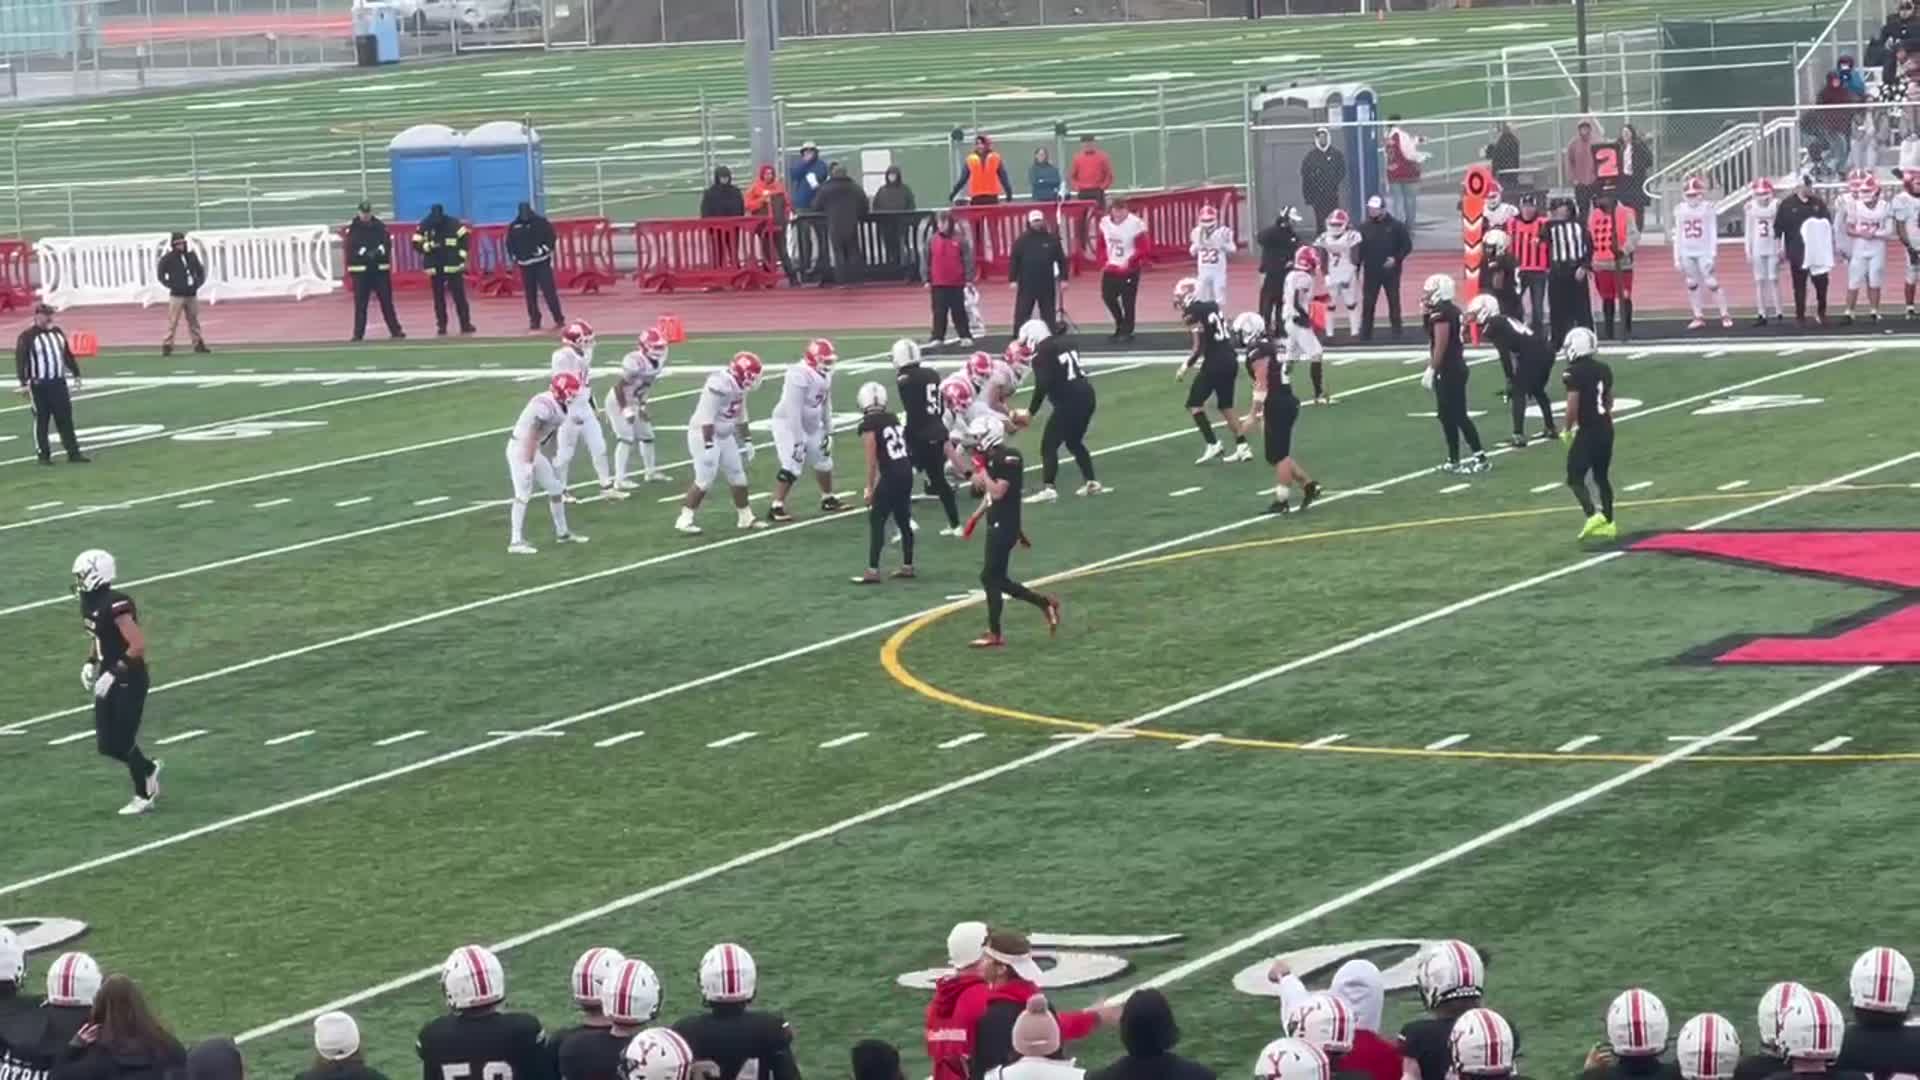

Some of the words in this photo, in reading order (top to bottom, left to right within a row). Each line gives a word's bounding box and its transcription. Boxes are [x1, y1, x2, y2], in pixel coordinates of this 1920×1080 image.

[1595, 148, 1619, 177] 2
[1684, 219, 1704, 239] 25
[1757, 219, 1769, 238] 3
[1200, 247, 1220, 264] 23
